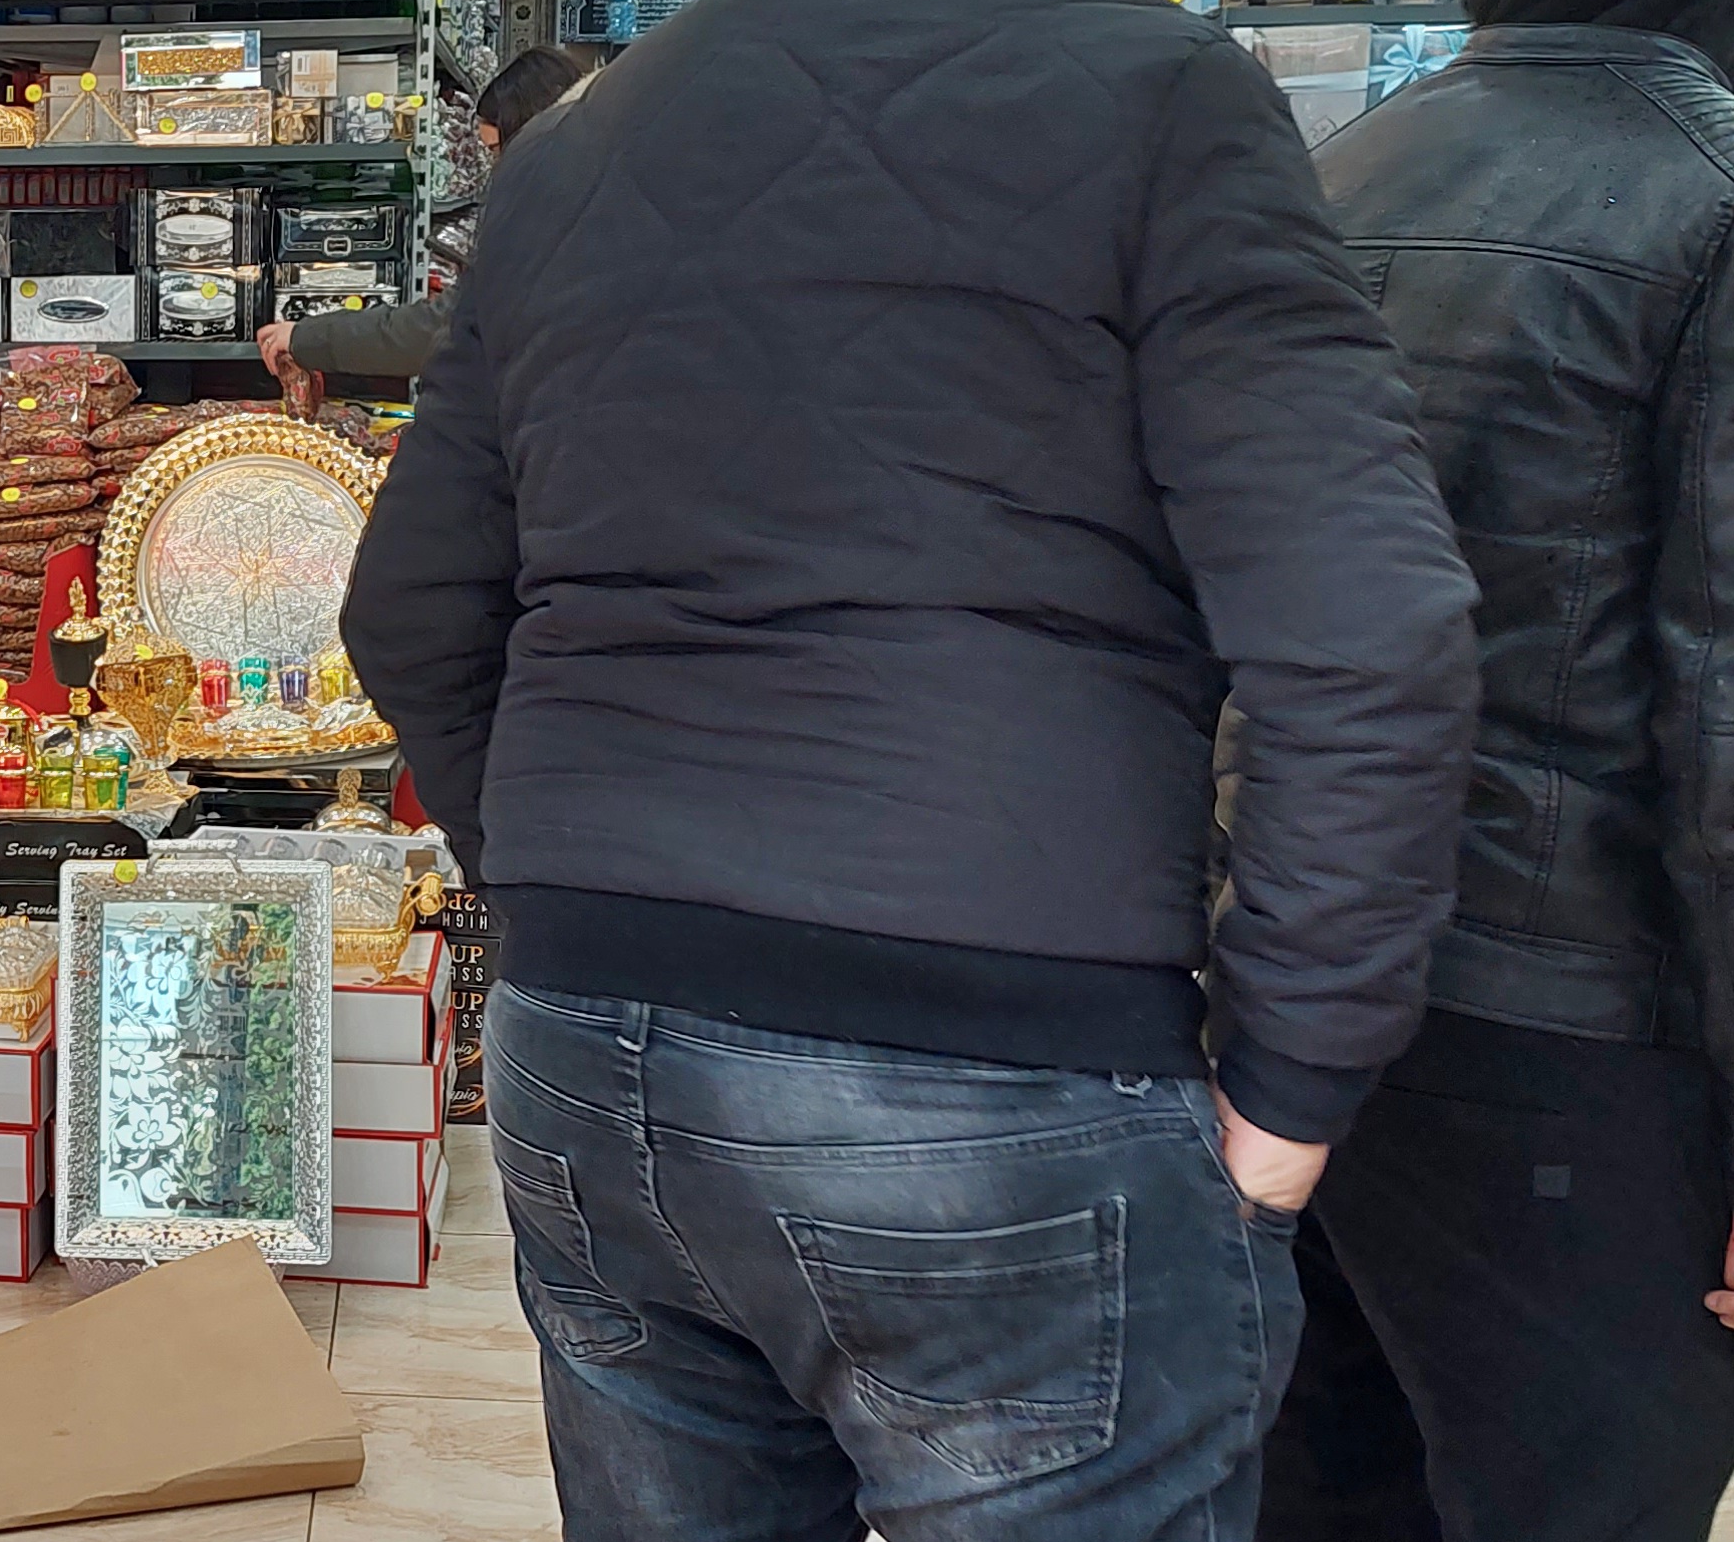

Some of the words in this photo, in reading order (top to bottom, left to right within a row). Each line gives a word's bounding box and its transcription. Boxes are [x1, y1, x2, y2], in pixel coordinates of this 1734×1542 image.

[5, 842, 58, 859] Serving
[66, 842, 99, 857] Tray
[101, 843, 128, 857] Set
[15, 902, 60, 916] Servin
[451, 945, 484, 965] UP
[452, 992, 484, 1011] UP
